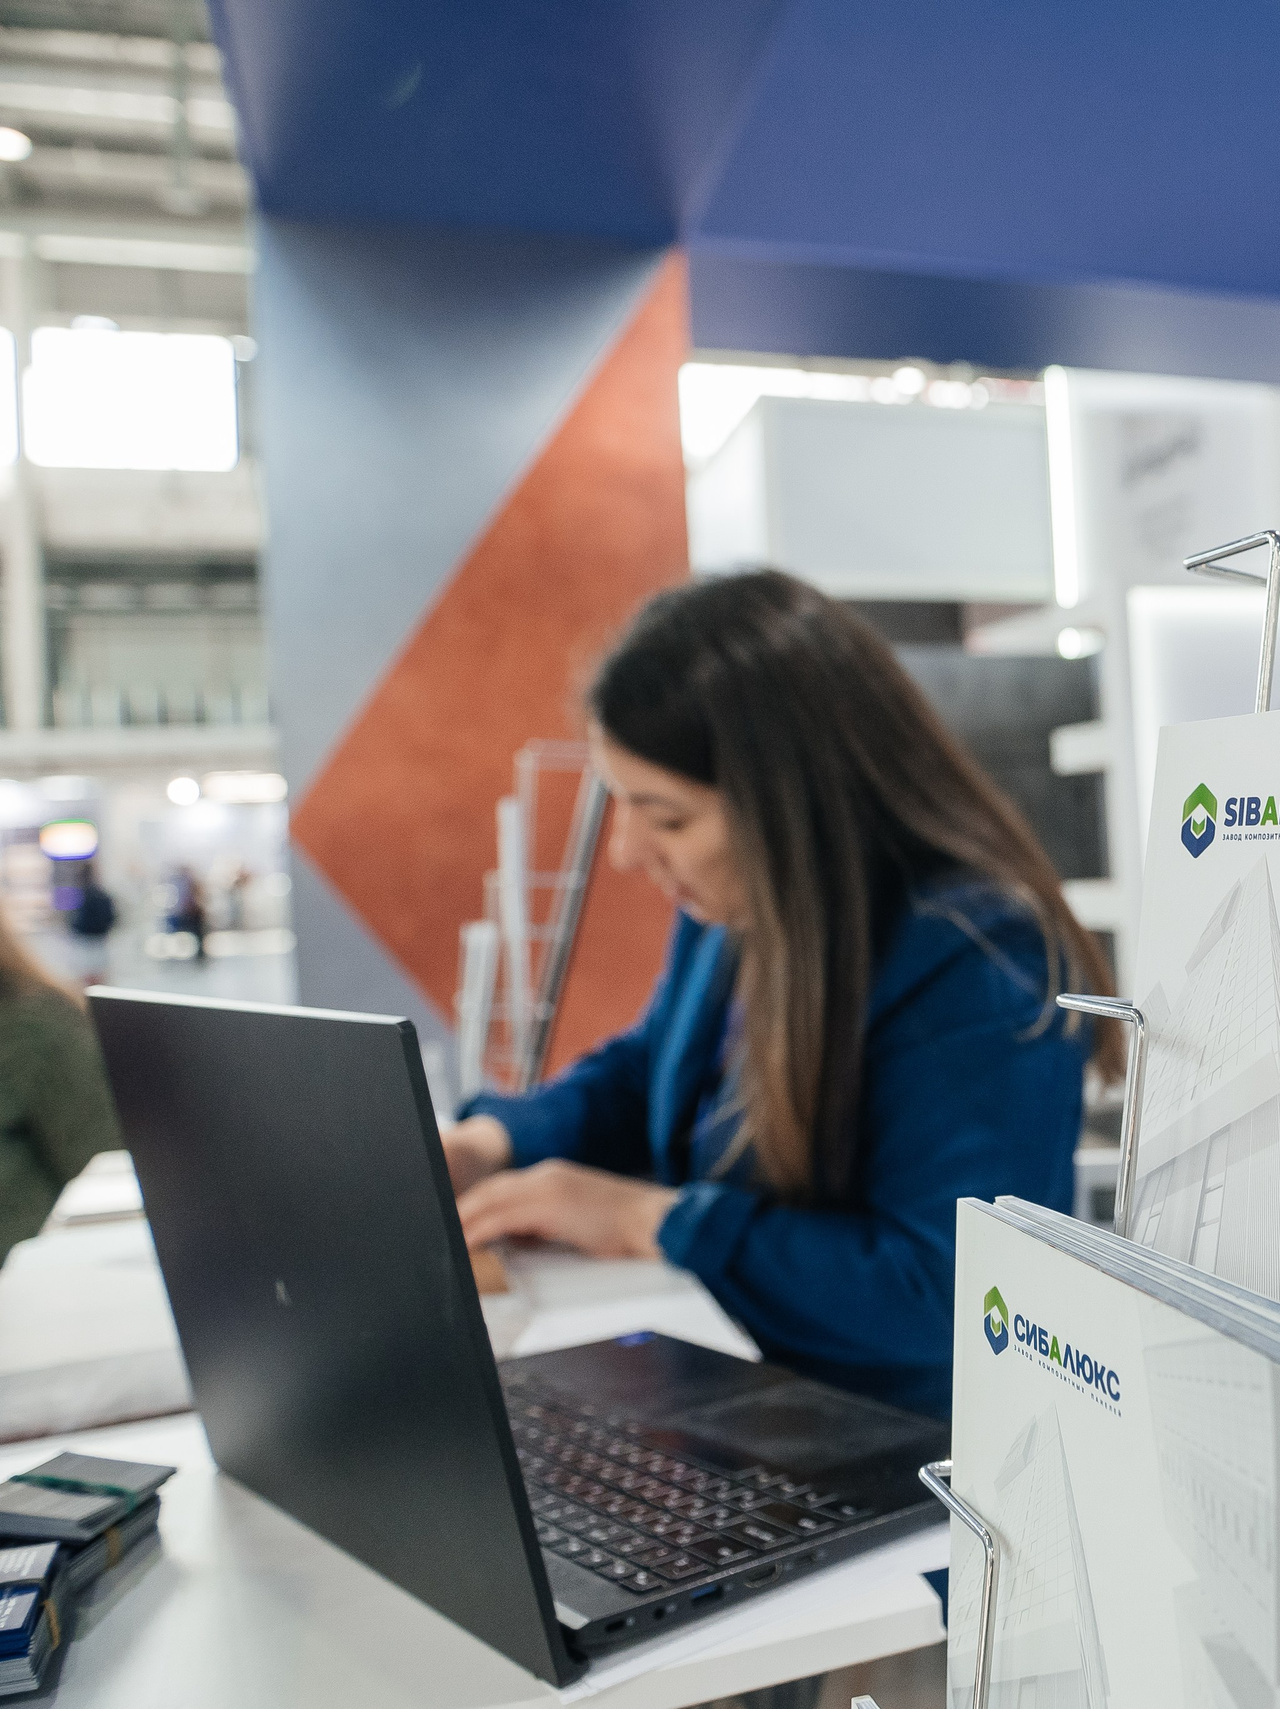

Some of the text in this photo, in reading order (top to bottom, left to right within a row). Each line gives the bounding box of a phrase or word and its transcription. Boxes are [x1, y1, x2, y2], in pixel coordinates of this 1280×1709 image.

[1222, 833, 1243, 842] ЗАВОД
[1013, 1313, 1121, 1402] СИБАЛЮКС
[1013, 1344, 1122, 1418] ЗАВОД КОМПОЗИТНЫХ ПАНЕЛЕЙ
